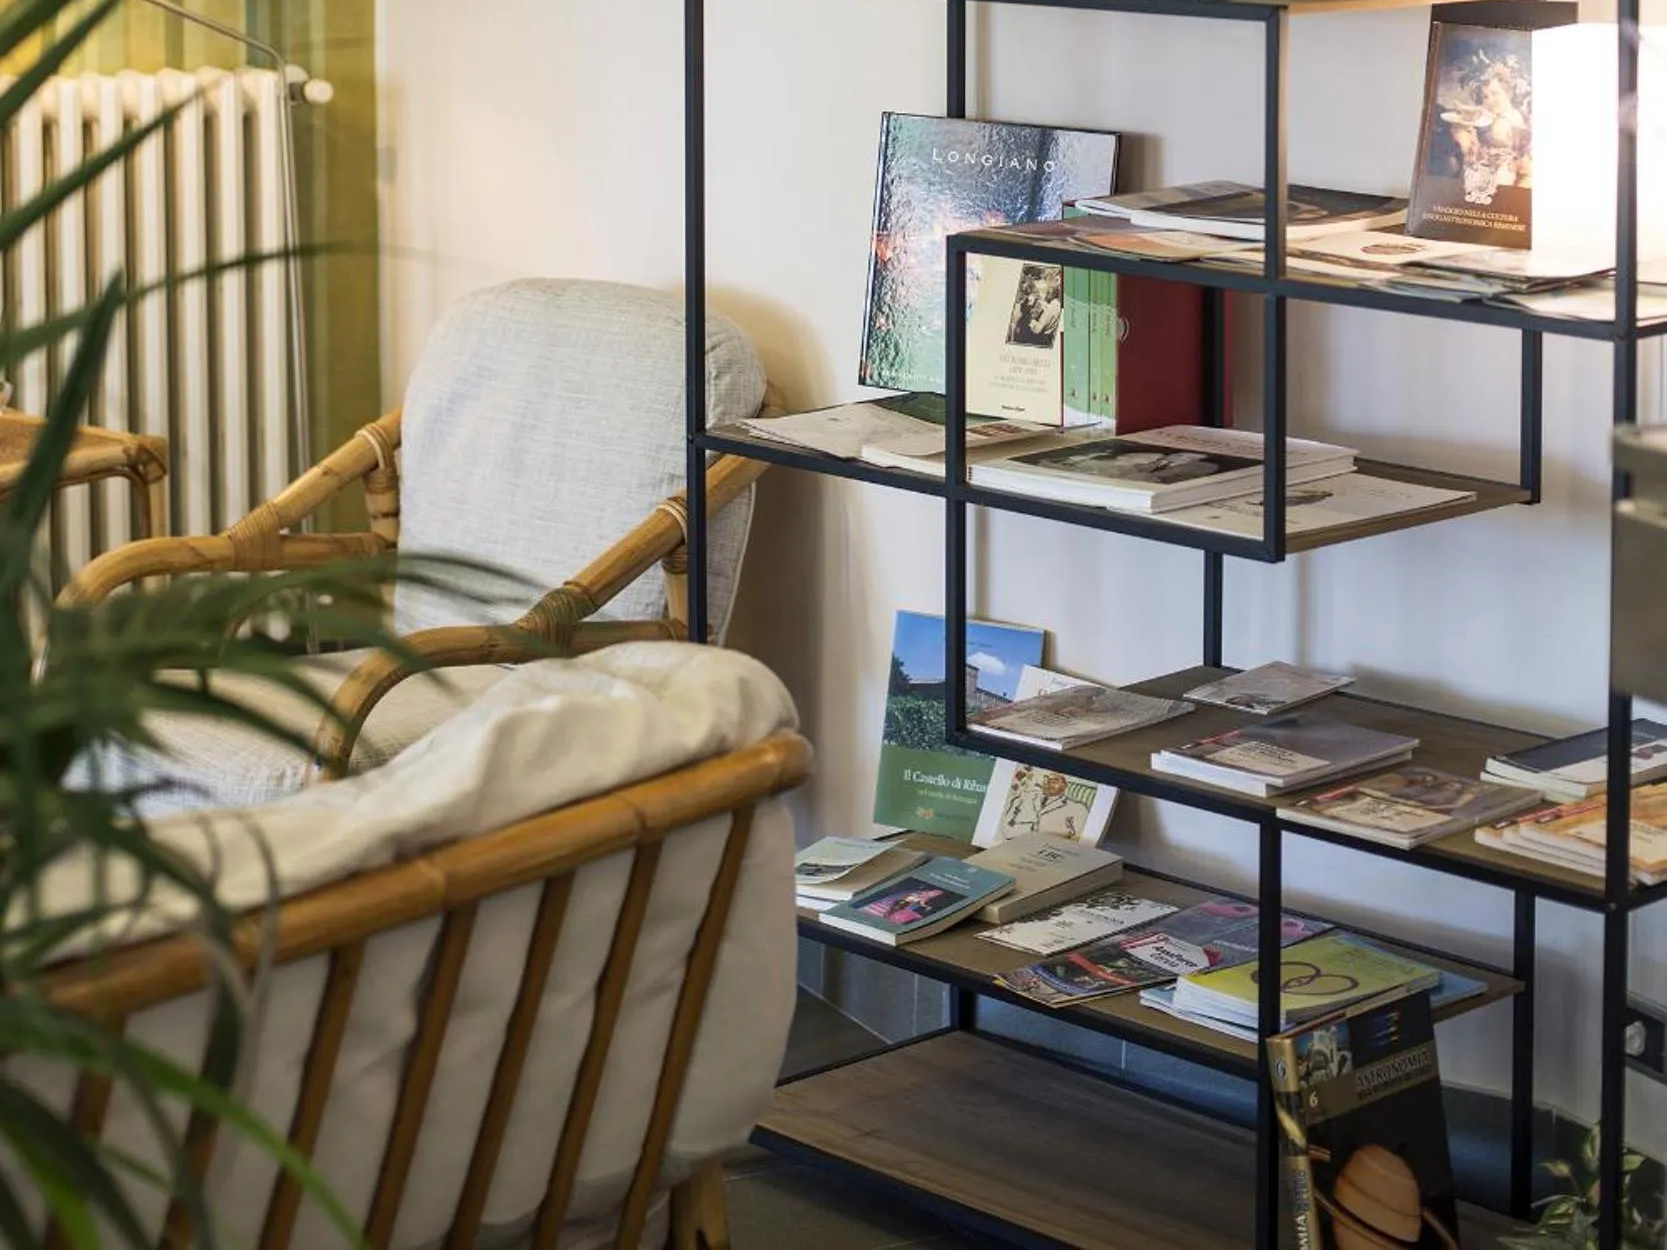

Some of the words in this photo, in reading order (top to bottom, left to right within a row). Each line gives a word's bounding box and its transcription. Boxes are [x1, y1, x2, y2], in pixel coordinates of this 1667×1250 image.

[932, 148, 1055, 172] LONGIANO
[912, 770, 950, 787] Castello
[1309, 1091, 1318, 1107] 6
